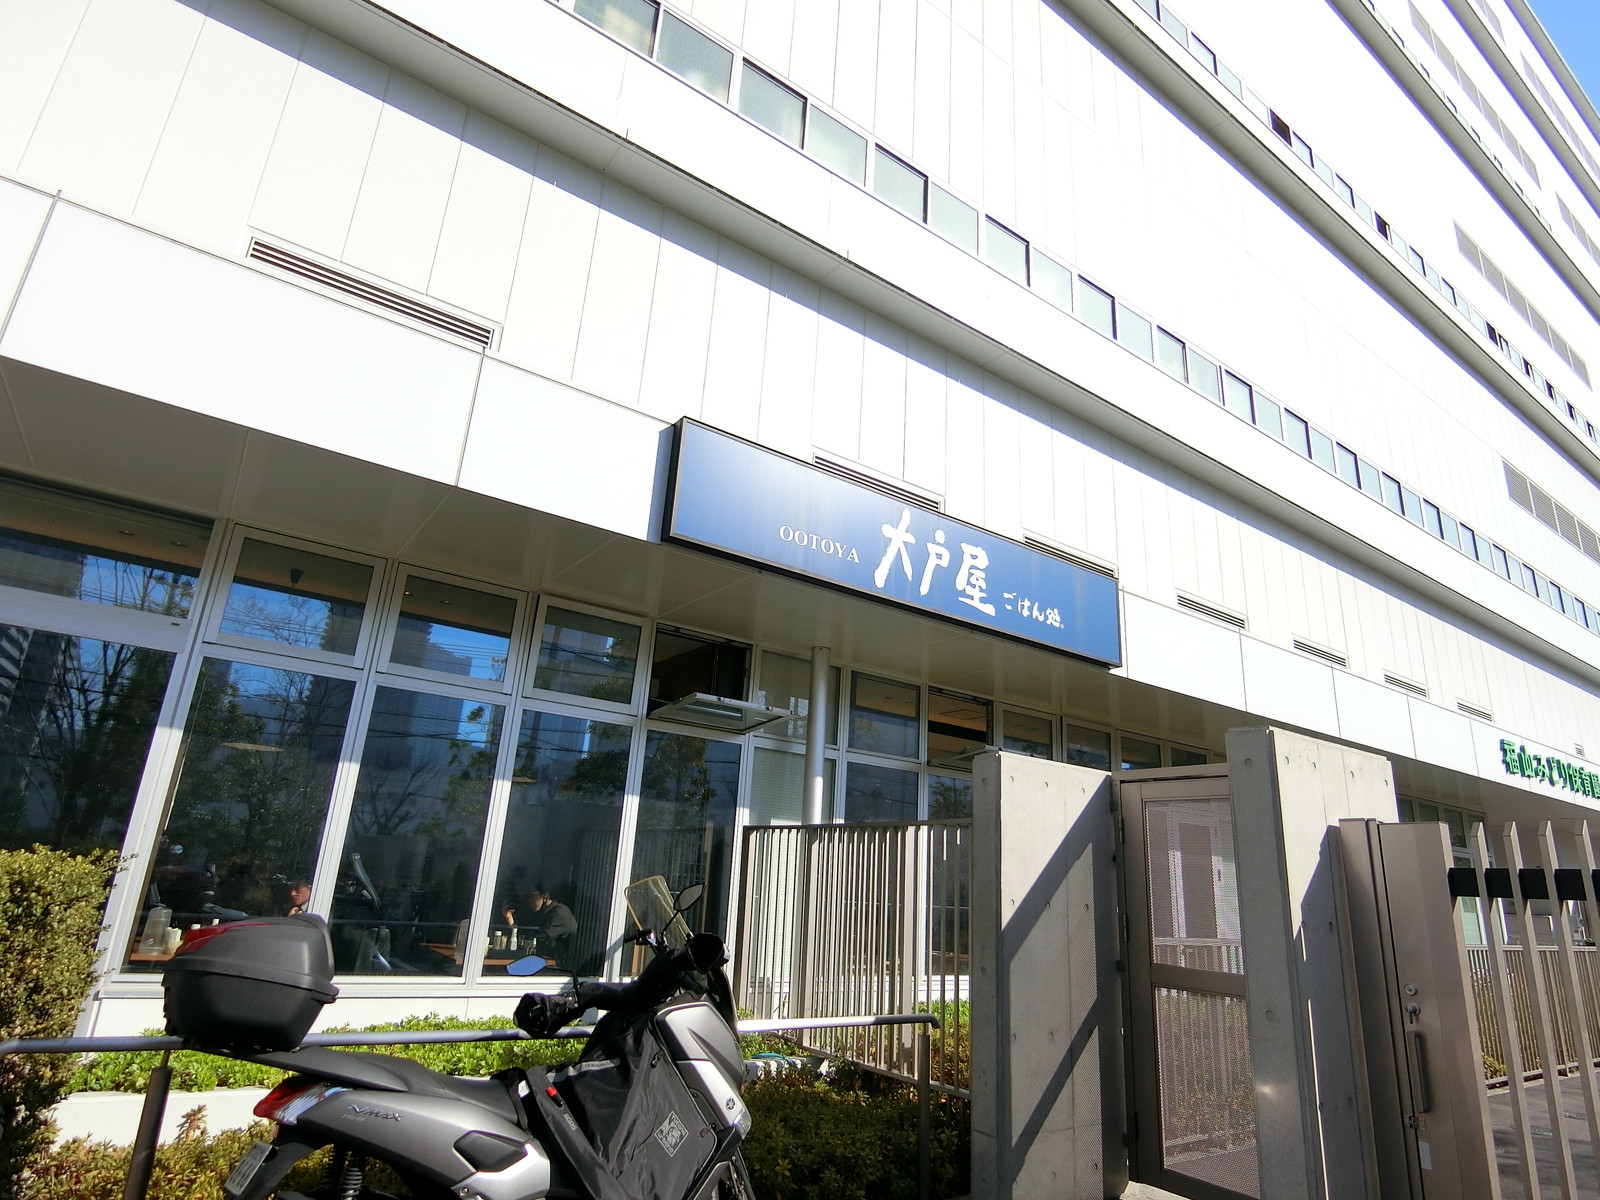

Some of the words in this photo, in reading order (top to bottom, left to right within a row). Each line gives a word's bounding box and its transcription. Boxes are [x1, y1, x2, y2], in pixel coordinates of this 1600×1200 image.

[778, 523, 861, 564] OOTOYA
[873, 508, 996, 617] 大戸屋
